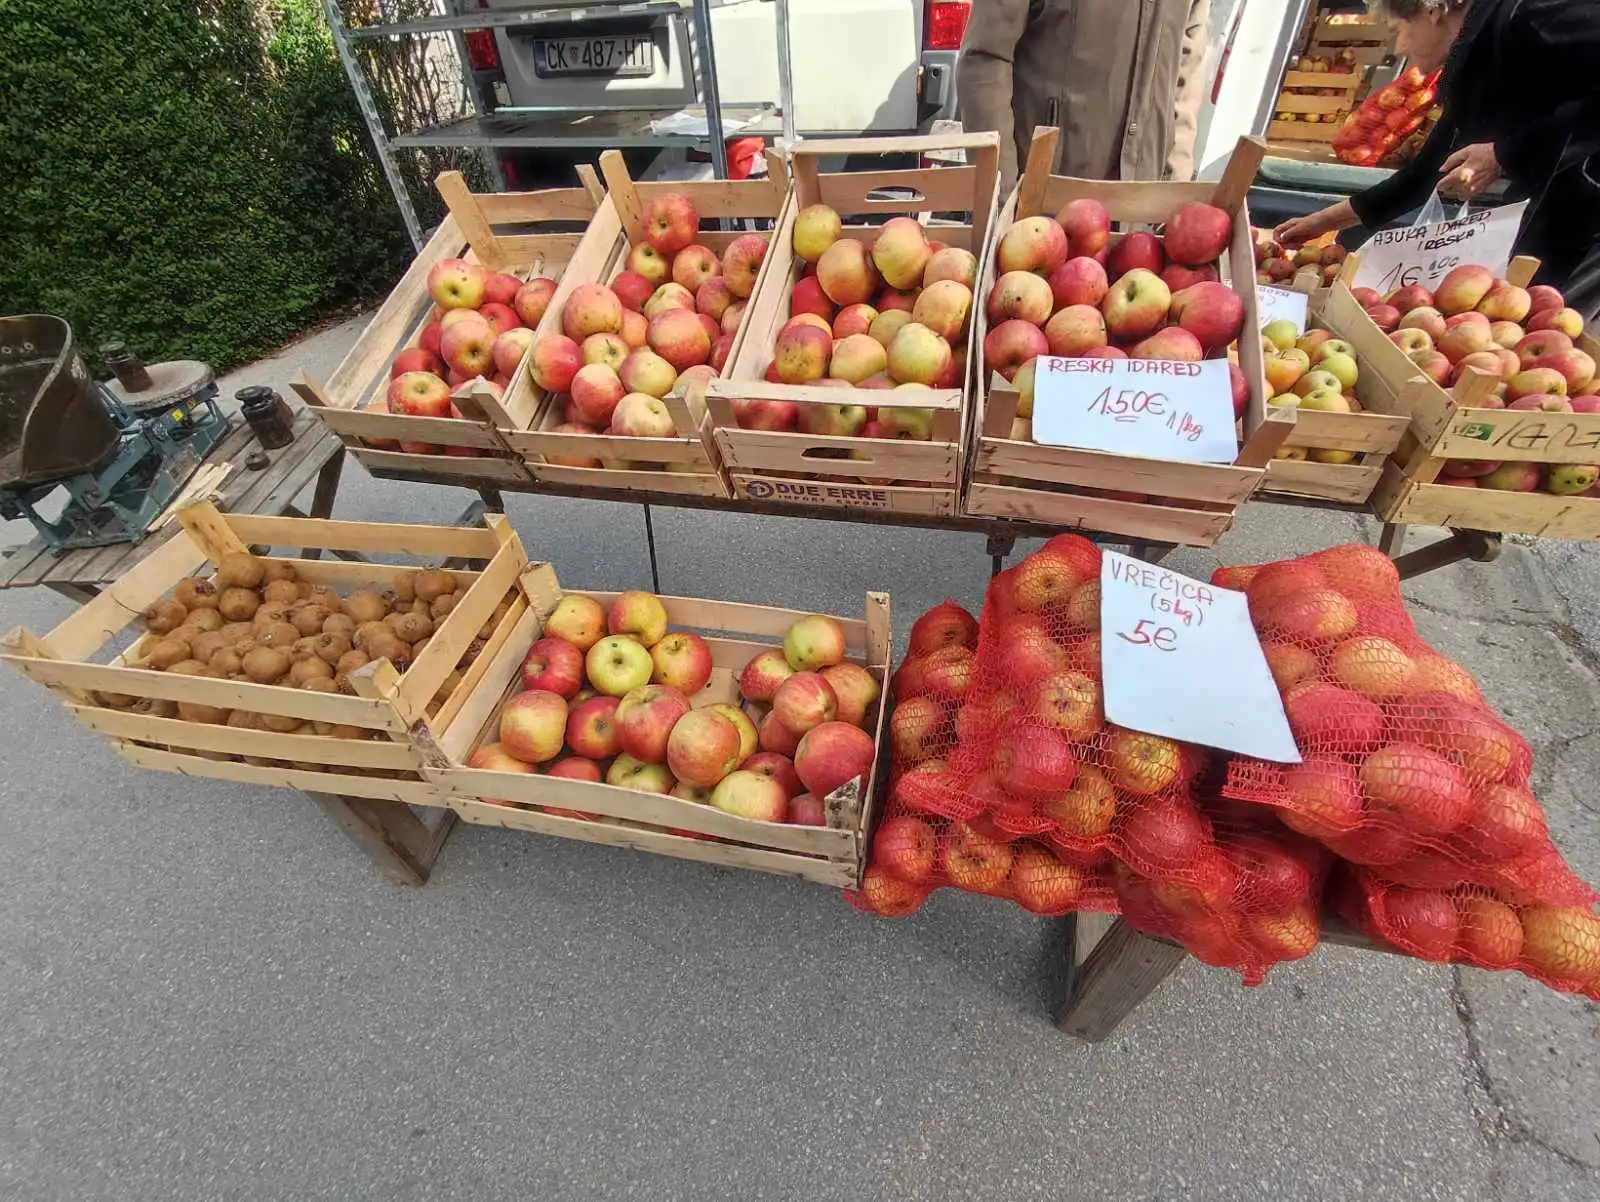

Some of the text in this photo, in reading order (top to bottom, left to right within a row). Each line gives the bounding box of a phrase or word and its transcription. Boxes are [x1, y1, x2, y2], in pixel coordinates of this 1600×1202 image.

[548, 42, 568, 69] CK
[1049, 358, 1203, 377] RESKA IDARED
[775, 483, 820, 497] DUE
[826, 487, 887, 501] ERRE
[1111, 558, 1214, 606] VREČICA
